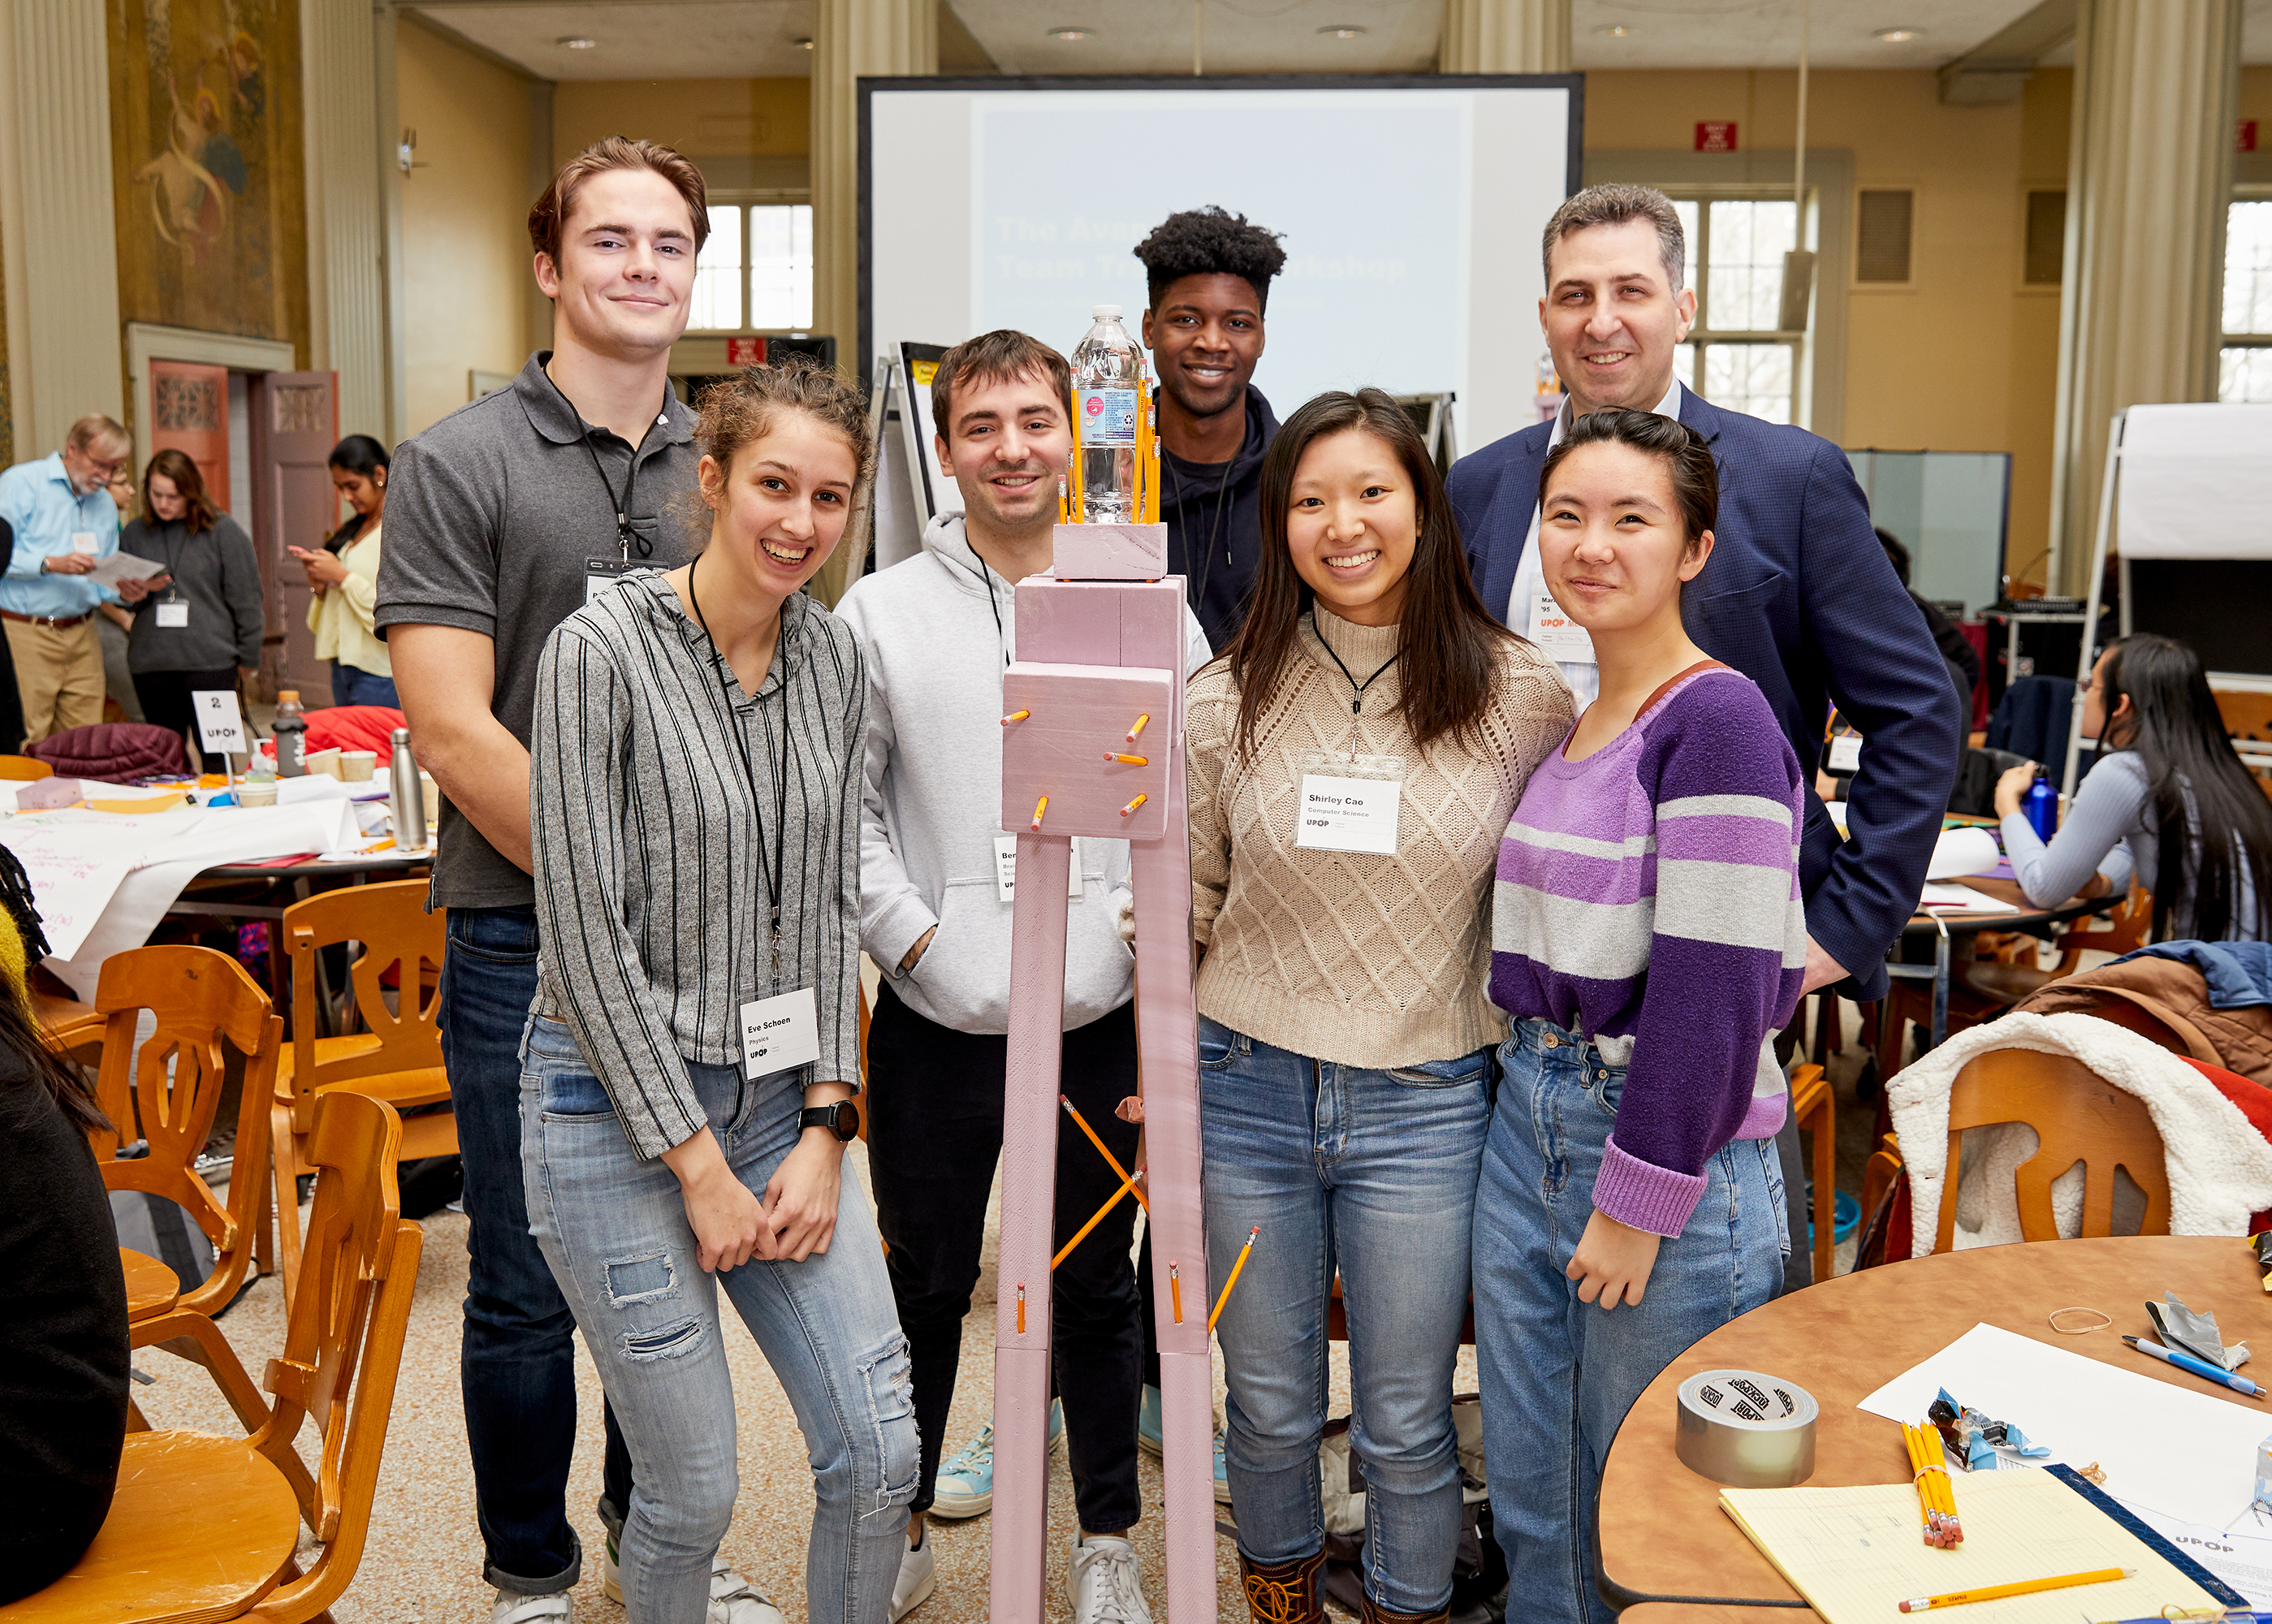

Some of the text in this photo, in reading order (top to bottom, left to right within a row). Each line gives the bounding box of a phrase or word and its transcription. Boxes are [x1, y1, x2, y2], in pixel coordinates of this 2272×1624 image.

[995, 217, 1057, 242] The
[995, 254, 1085, 279] Team
[1097, 254, 1147, 279] Tra
[1540, 618, 1565, 628] UPOP
[211, 697, 221, 708] 2
[1309, 794, 1363, 806] Shirley Cao
[1307, 806, 1370, 818] Computer Science
[1306, 818, 1329, 827] UPOP
[748, 1017, 791, 1034] Eve Schoen
[749, 1035, 769, 1046] Physics
[749, 1048, 768, 1059] UPOP
[2175, 1535, 2234, 1553] UPOP
[1947, 1593, 1967, 1602] STAPLES
